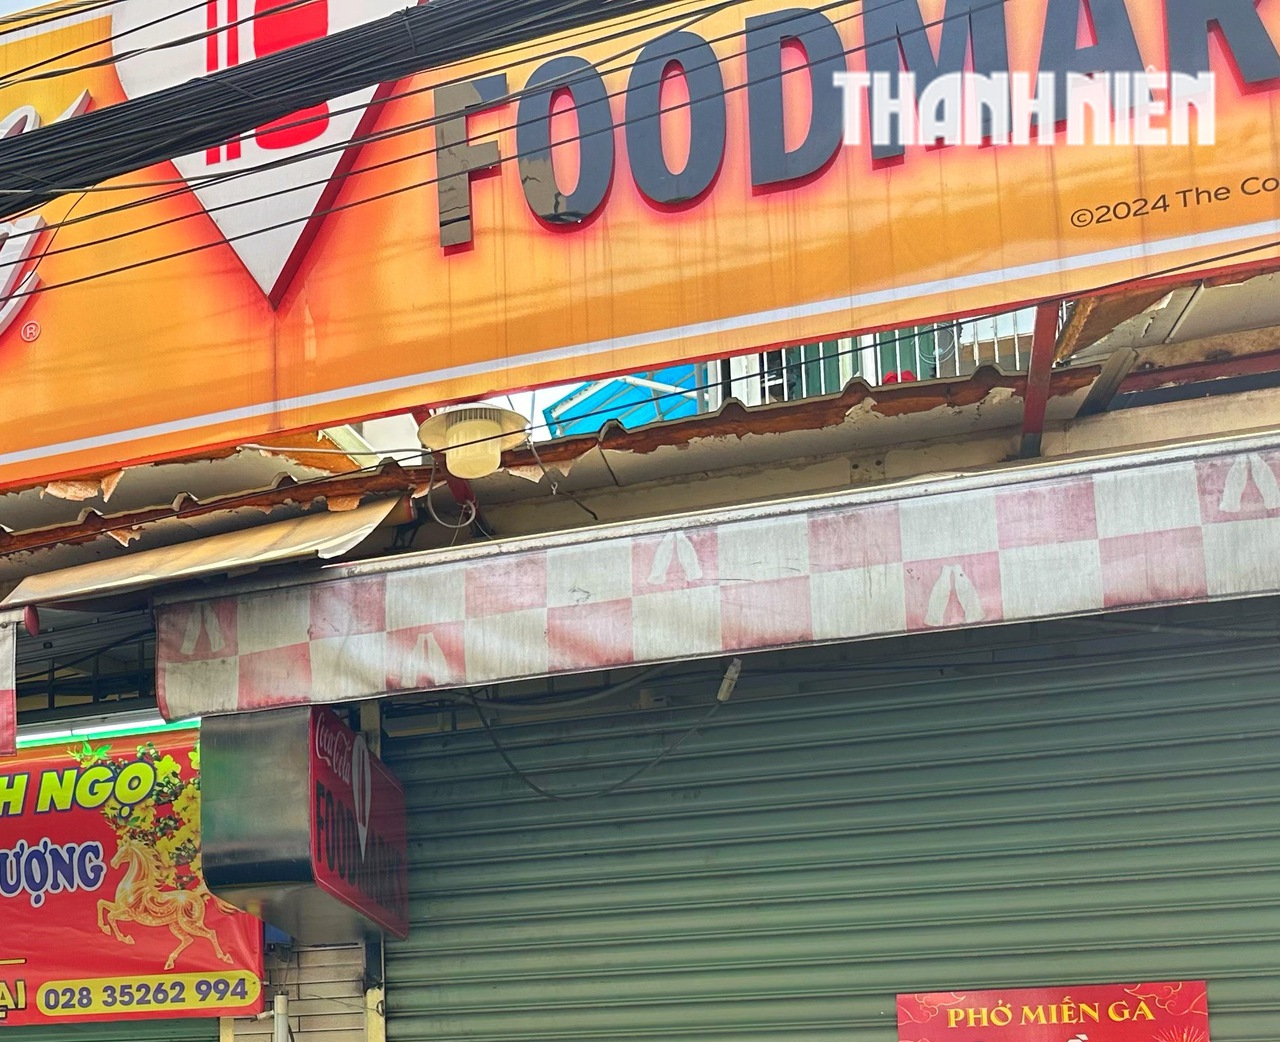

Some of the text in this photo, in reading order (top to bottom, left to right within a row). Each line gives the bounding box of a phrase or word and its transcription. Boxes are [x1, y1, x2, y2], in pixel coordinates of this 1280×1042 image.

[1176, 180, 1230, 208] The
[1240, 176, 1280, 195] Co
[36, 762, 155, 818] NGỌ
[43, 977, 249, 1010] 028 35262 994
[947, 995, 1155, 1029] PHỞ MIẾN GÀ
